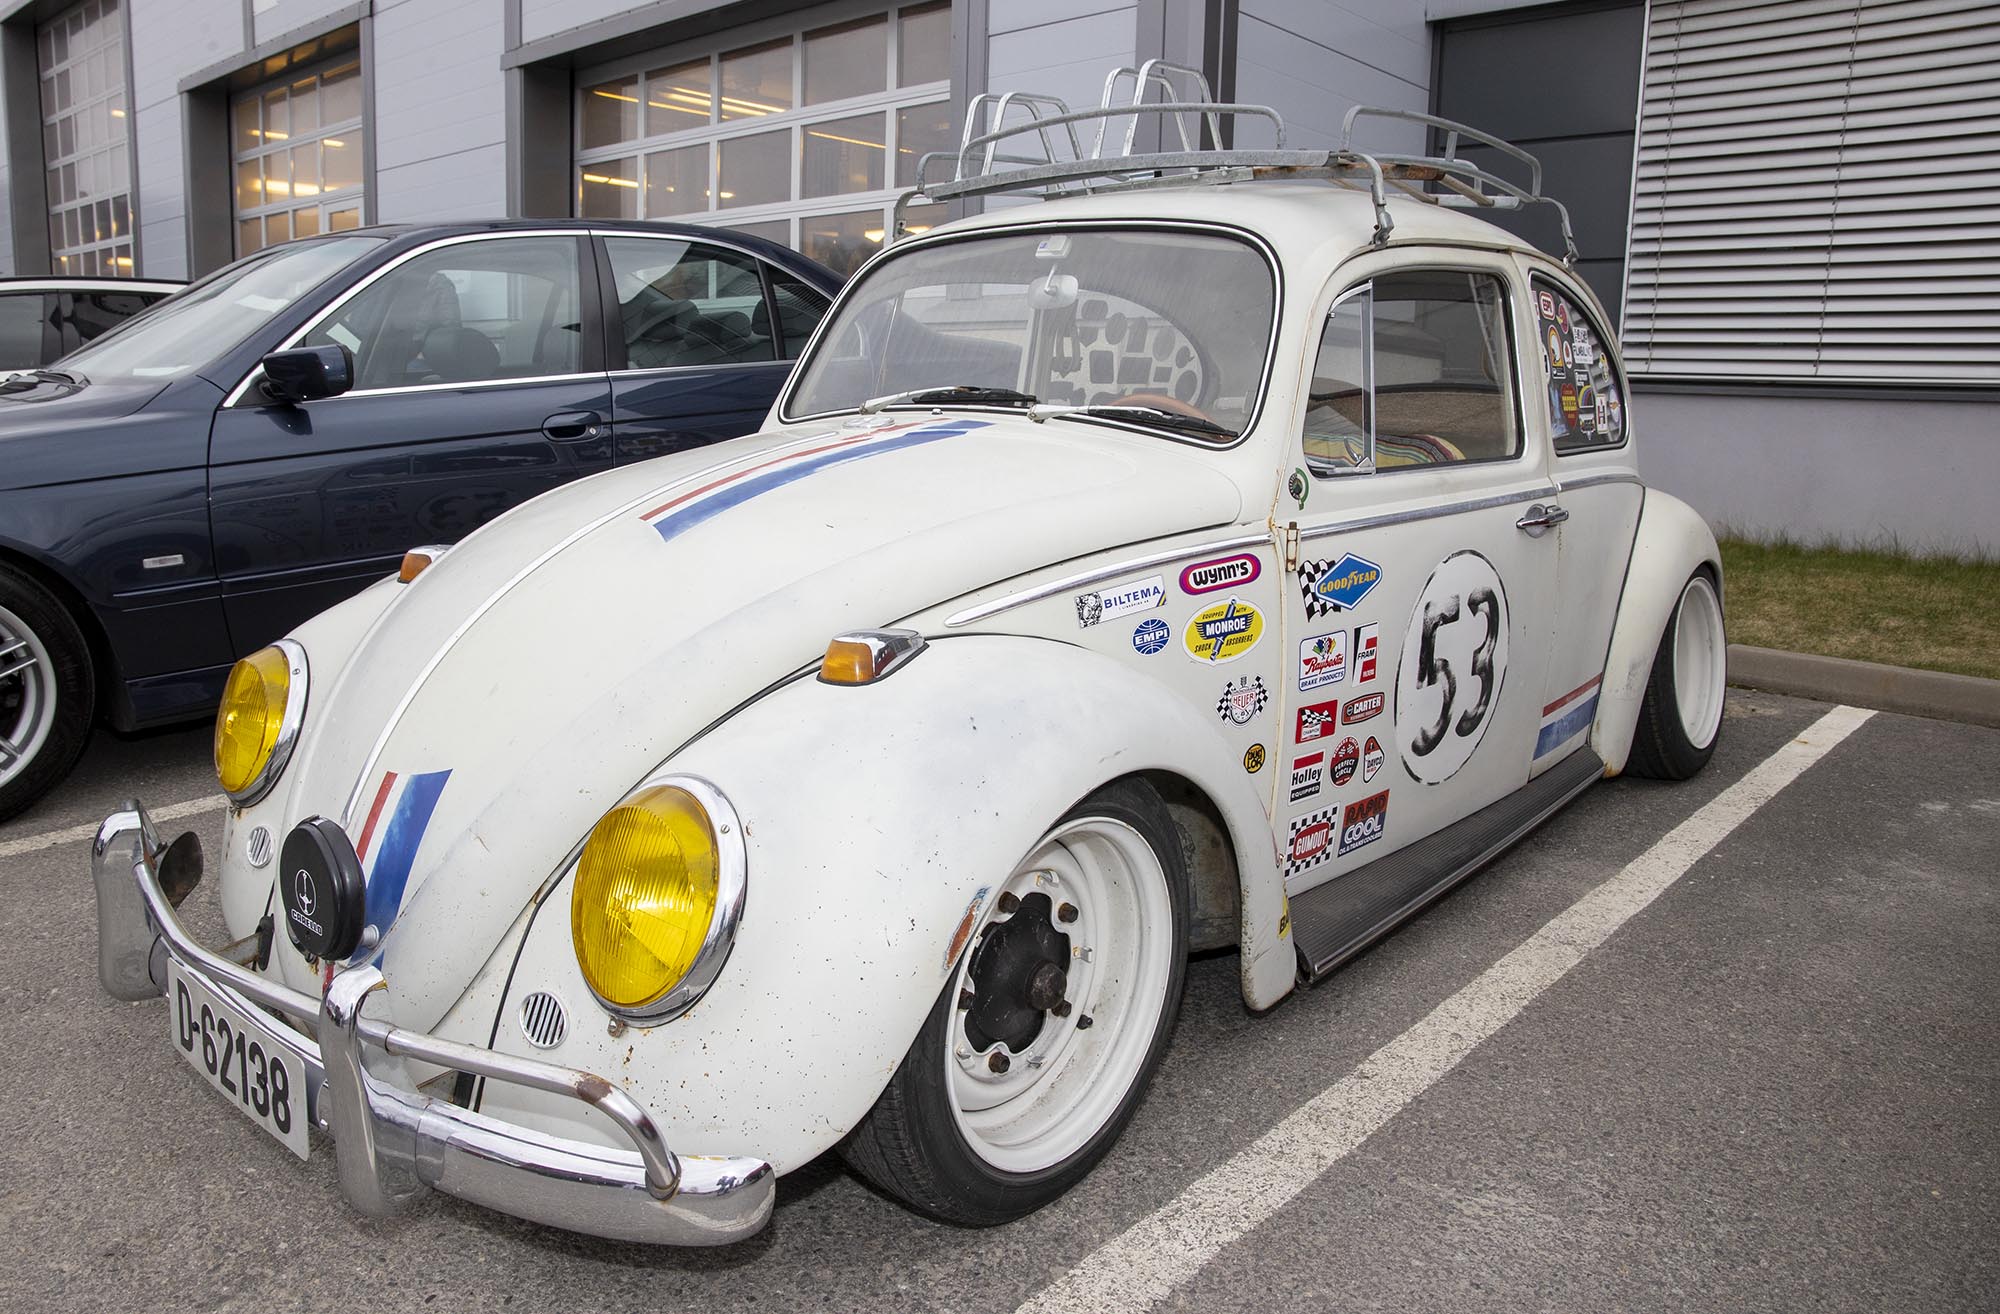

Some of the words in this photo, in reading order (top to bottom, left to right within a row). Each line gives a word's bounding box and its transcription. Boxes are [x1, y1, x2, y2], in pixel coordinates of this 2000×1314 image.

[1193, 560, 1250, 586] wynn's
[1319, 570, 1377, 594] GOODYEAR
[1104, 585, 1161, 609] BILTEMA
[1202, 610, 1225, 620] EQUIPPED
[1206, 617, 1247, 637] MONROE
[1135, 628, 1169, 646] EMPI
[1194, 642, 1212, 653] SHOCK
[1225, 634, 1254, 647] ABSORBERS
[1357, 649, 1375, 661] FRAM
[1301, 676, 1318, 687] BRAKE
[1319, 670, 1344, 682] PRODUCTS
[1411, 587, 1500, 757] 53
[1233, 692, 1254, 708] HEUER
[1353, 696, 1381, 713] CARTER
[1334, 758, 1355, 772] PERFECT
[1366, 756, 1383, 769] DAYCO
[1291, 766, 1323, 786] Holley
[1335, 767, 1352, 779] CIRCLE
[1291, 785, 1320, 798] EQUIPPED
[1347, 795, 1387, 823] RAPID
[1344, 814, 1382, 844] COOL
[1296, 828, 1329, 856] GUMOUT
[177, 978, 291, 1134] D-62138
